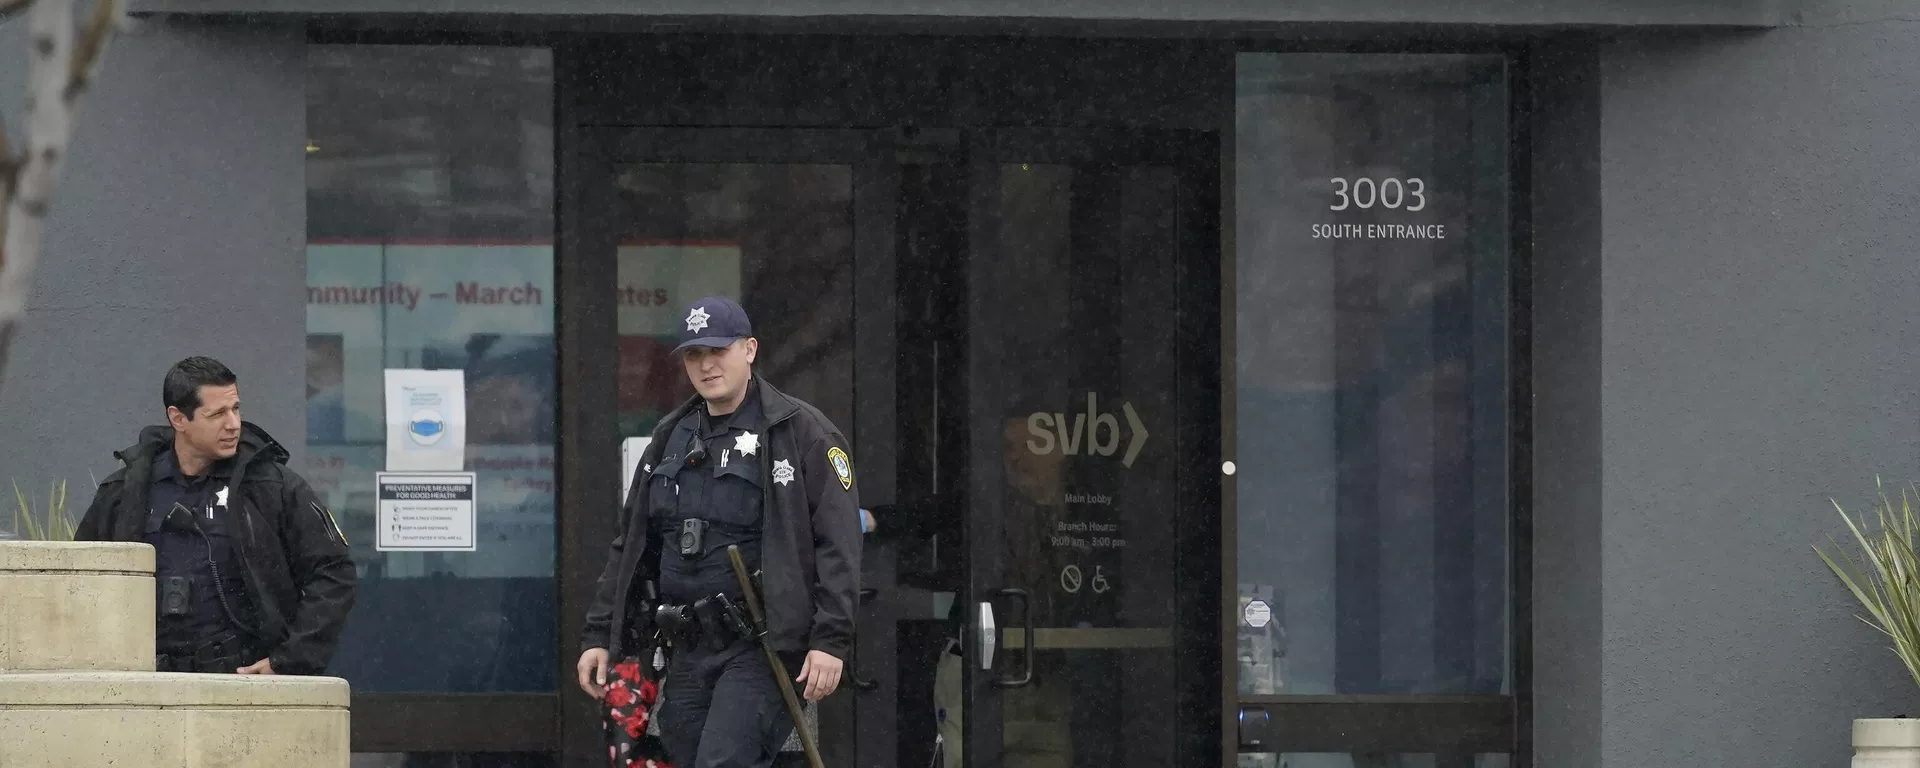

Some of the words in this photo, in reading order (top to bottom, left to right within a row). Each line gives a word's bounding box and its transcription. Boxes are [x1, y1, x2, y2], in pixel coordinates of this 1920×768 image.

[1330, 177, 1426, 211] 3003
[1312, 224, 1362, 238] SOUTH
[1367, 224, 1445, 239] ENTRANCE
[455, 281, 542, 304] March
[1026, 391, 1120, 456] svb
[1065, 492, 1085, 503] Main
[1087, 492, 1112, 506] Lobby
[1058, 521, 1087, 531] Branch
[1051, 536, 1070, 546] 9:00
[1092, 536, 1111, 547] 3:00
[1112, 539, 1126, 548] pm
